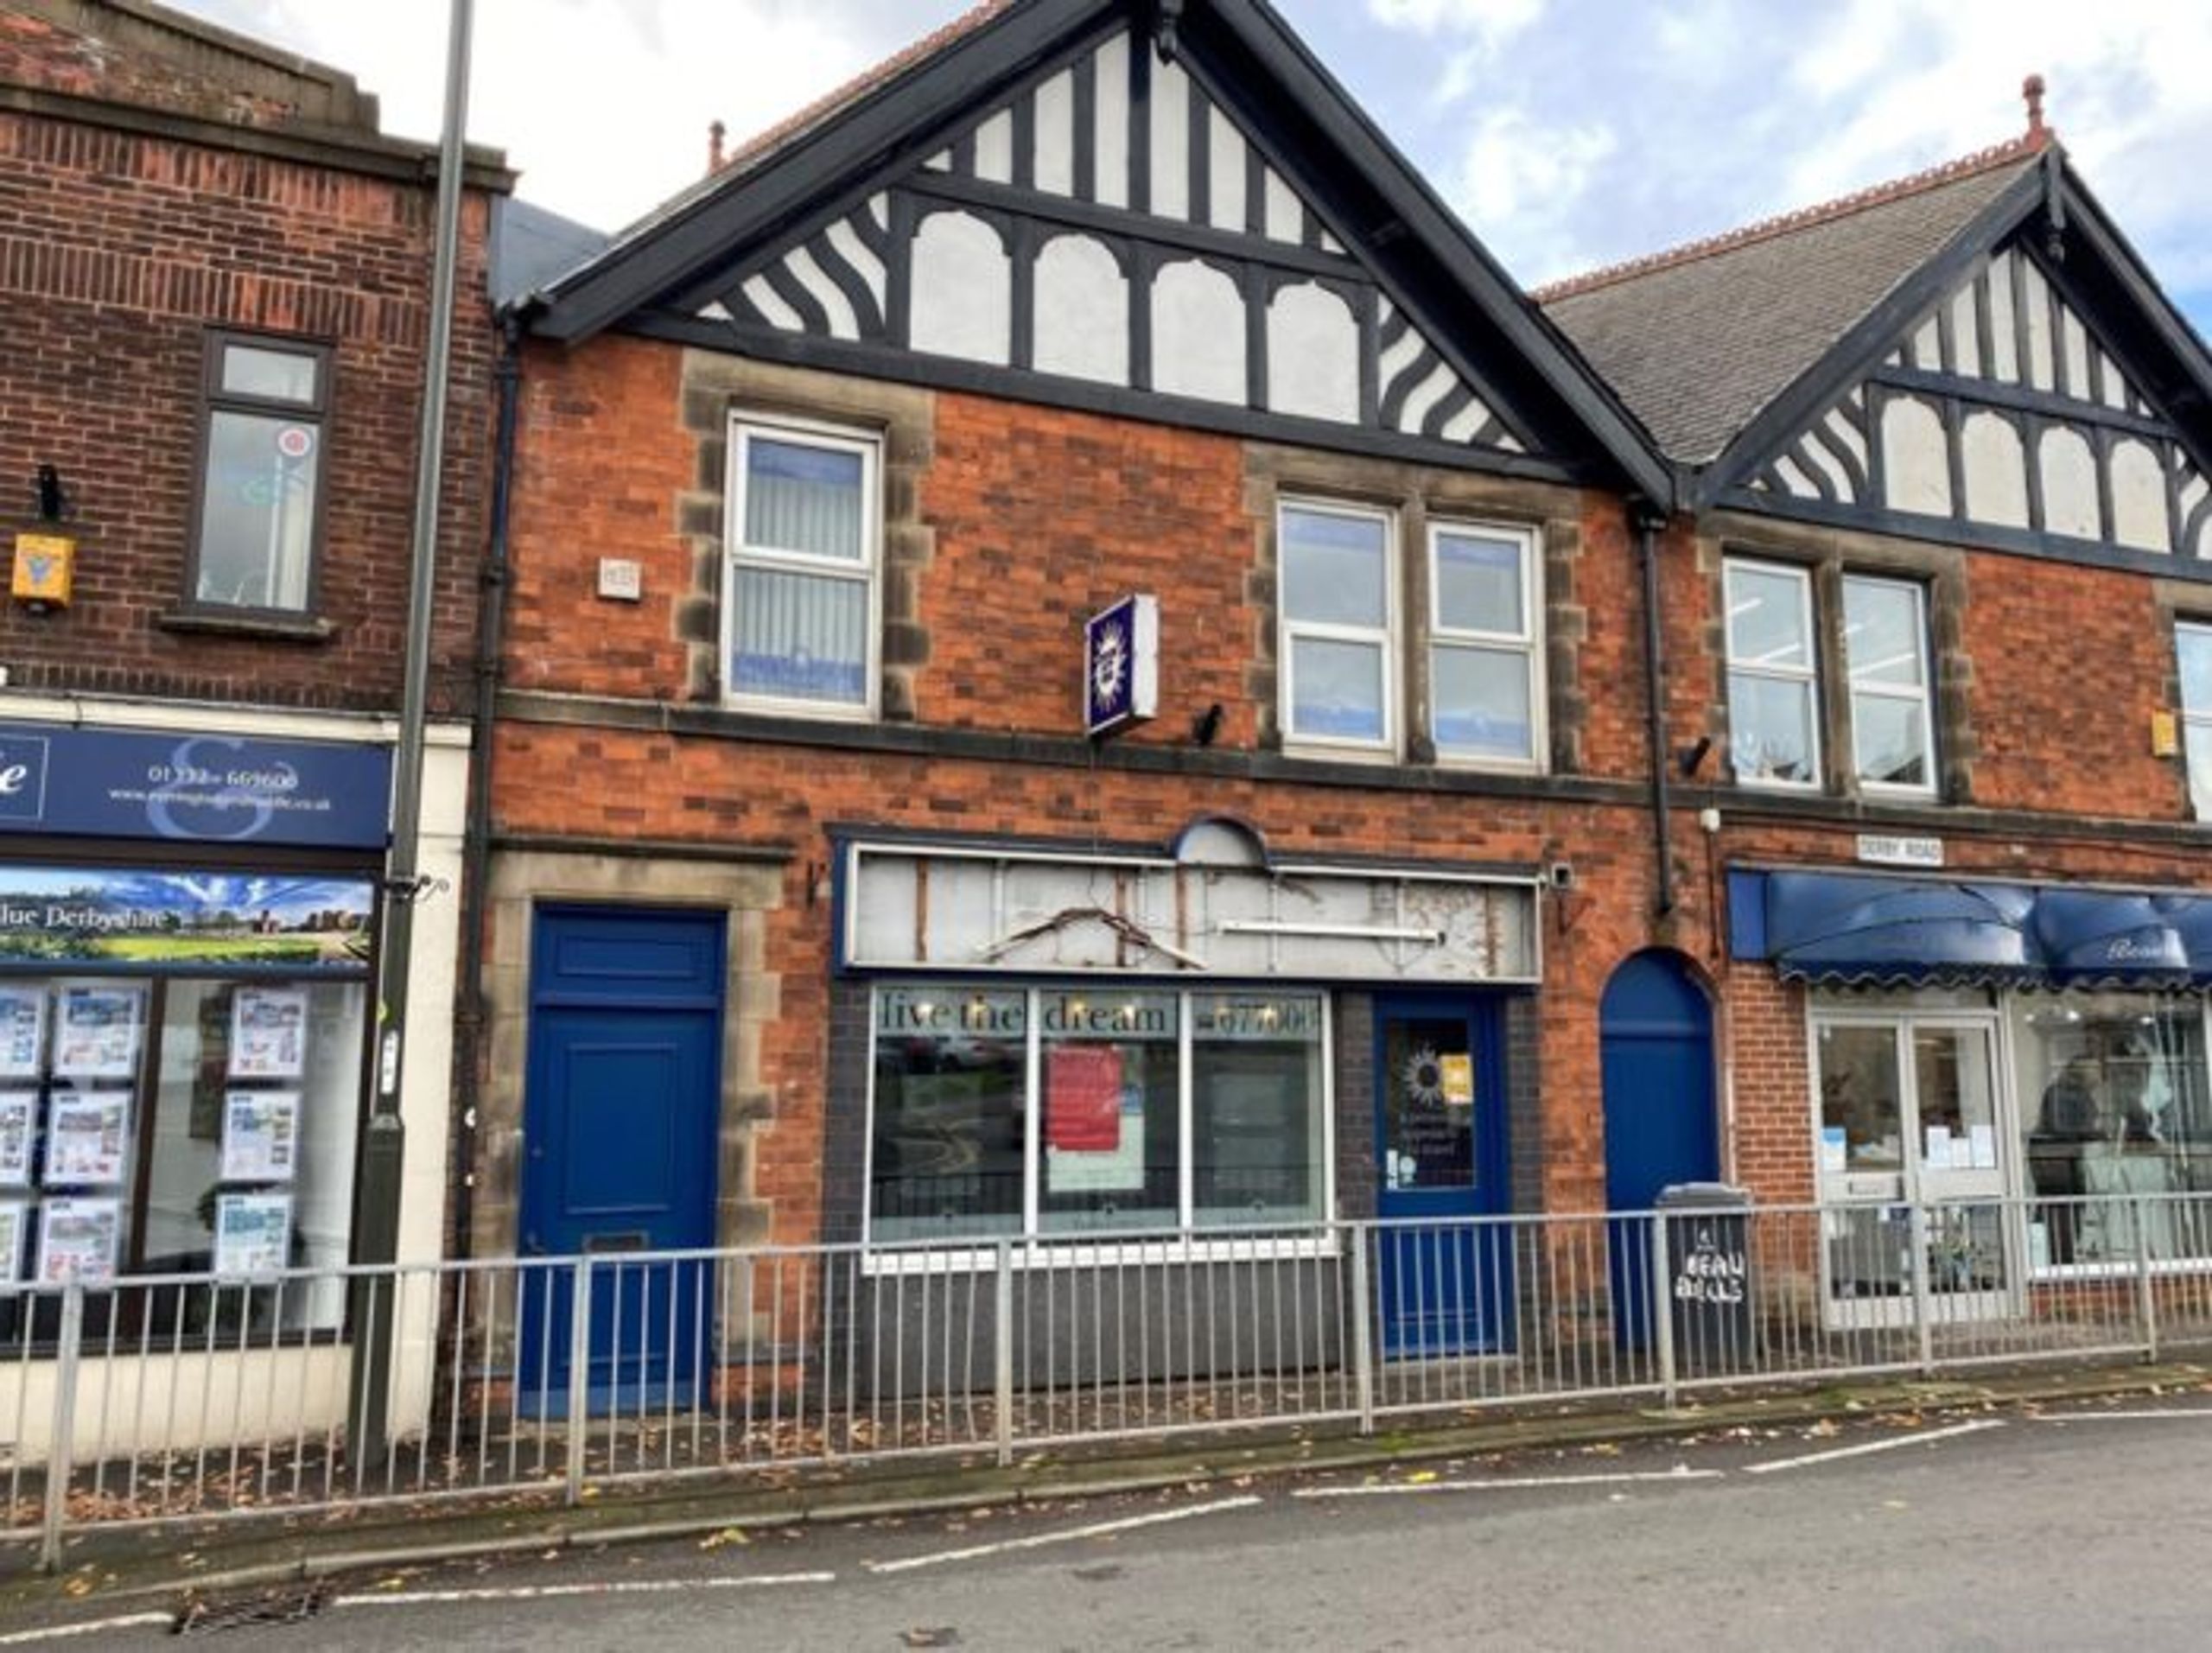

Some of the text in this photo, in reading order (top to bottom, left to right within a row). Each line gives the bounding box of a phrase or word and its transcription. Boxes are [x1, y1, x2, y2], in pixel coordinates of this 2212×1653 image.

[880, 994, 950, 1030] live
[959, 995, 1023, 1031] the
[1044, 996, 1166, 1033] dream
